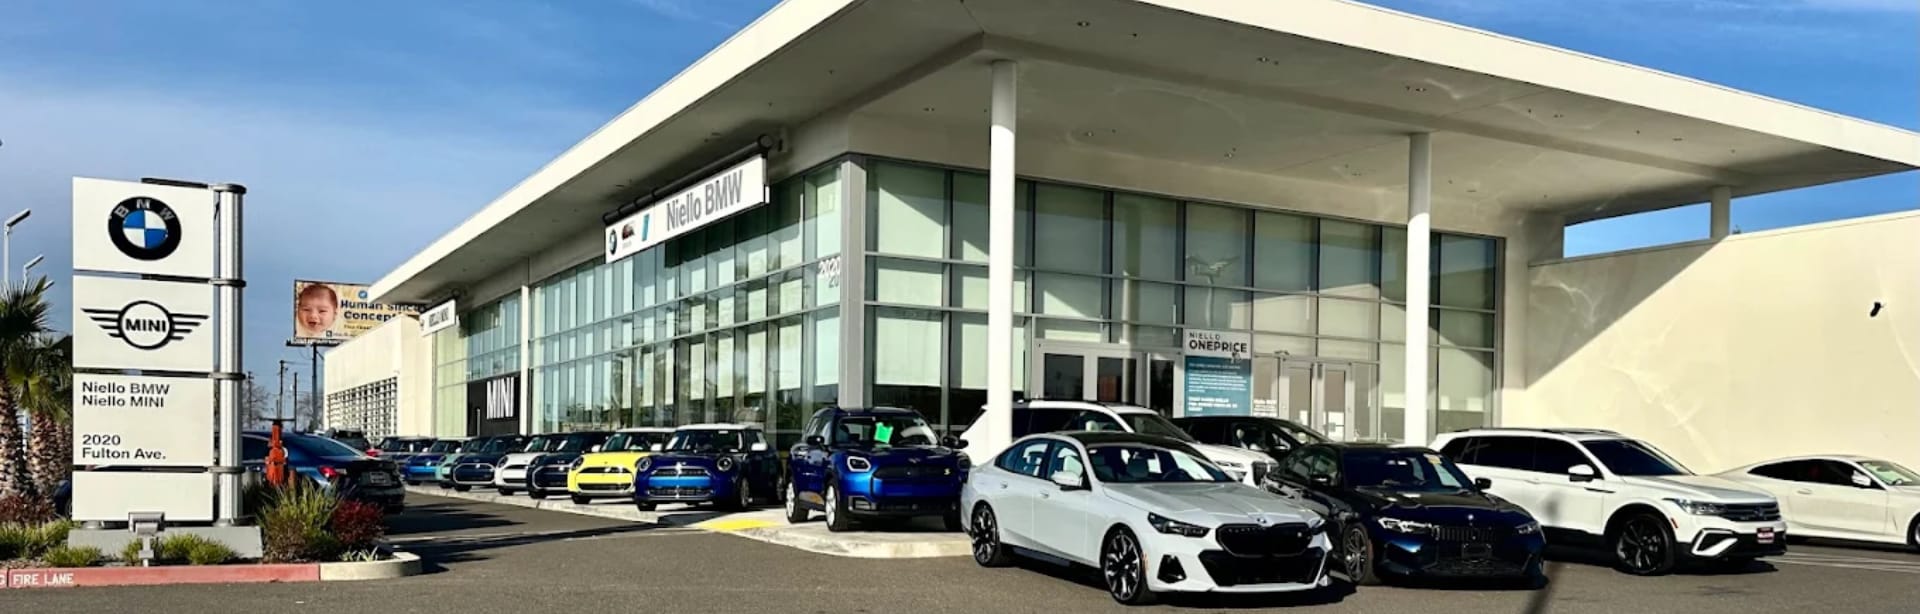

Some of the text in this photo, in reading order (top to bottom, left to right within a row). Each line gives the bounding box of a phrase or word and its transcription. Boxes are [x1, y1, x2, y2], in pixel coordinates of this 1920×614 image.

[666, 169, 743, 232] Niello BMW
[114, 199, 175, 222] BMW
[340, 299, 383, 311] Human
[125, 318, 167, 333] MINI
[1189, 332, 1220, 341] NIELLO
[1189, 339, 1248, 353] ONEPRICE
[82, 381, 170, 395] Niello BMW
[82, 394, 164, 408] Niello MINI
[486, 376, 515, 420] MINI
[82, 434, 121, 446] 2020
[82, 447, 166, 460] Fulton Ave.
[13, 573, 40, 585] FIRE
[44, 572, 74, 585] LANE
